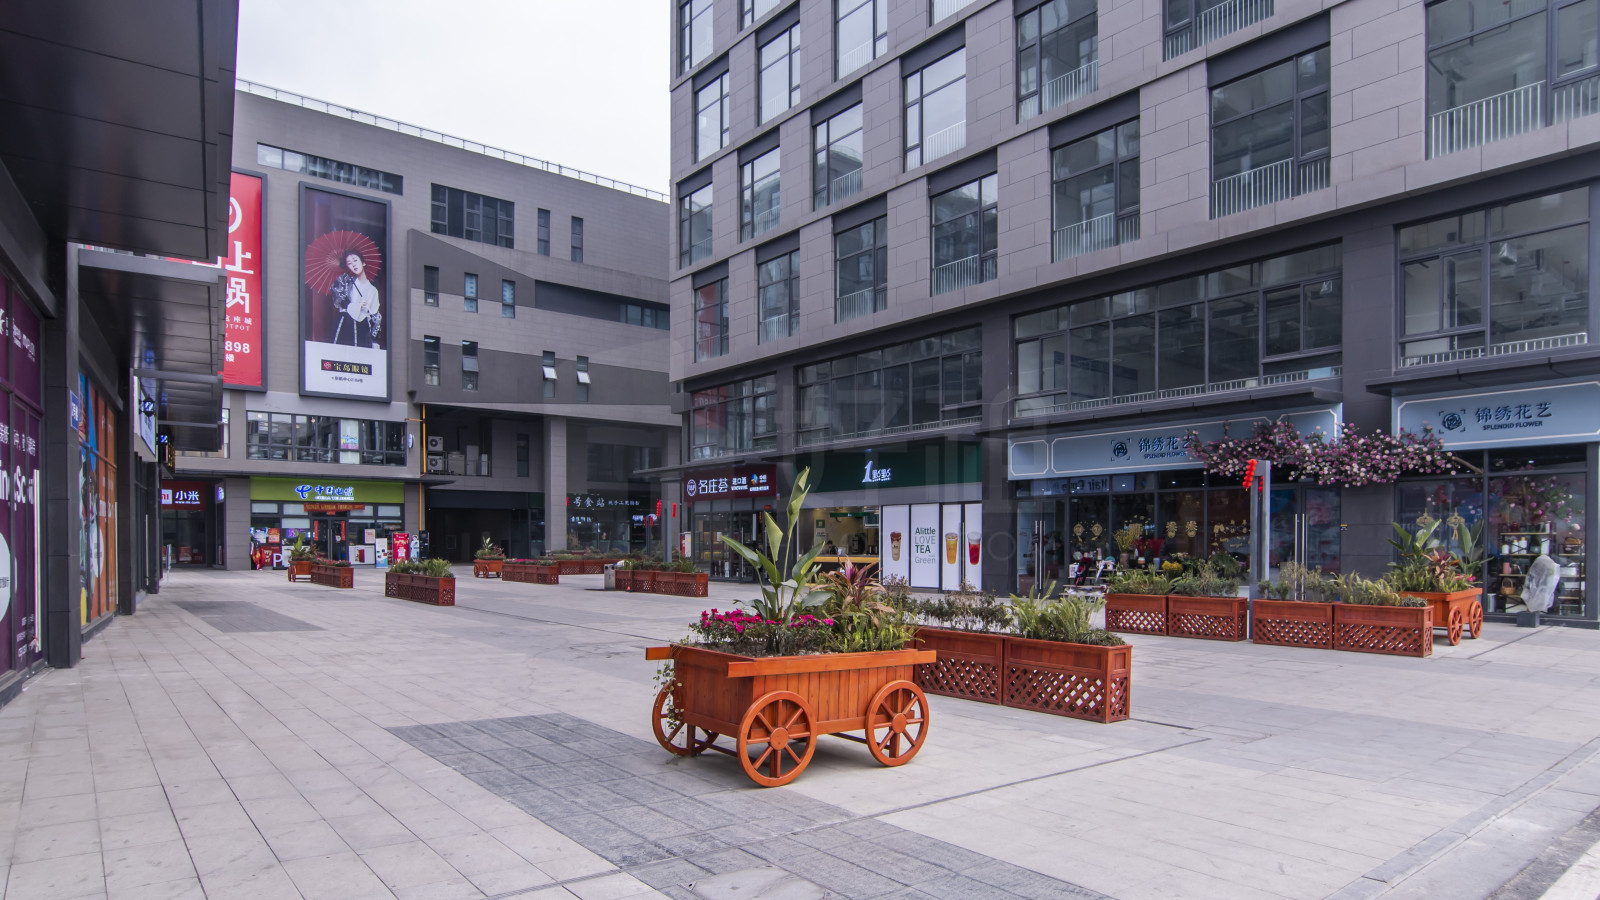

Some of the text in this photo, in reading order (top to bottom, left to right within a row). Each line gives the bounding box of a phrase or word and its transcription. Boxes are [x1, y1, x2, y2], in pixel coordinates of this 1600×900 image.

[1475, 402, 1552, 423] 锦绣花艺
[1483, 420, 1543, 431] SPLENDID FLOWER
[698, 477, 729, 494] 名庄荟
[175, 490, 200, 500] 小米
[914, 536, 936, 544] LOVE
[914, 544, 931, 554] TEA
[914, 556, 936, 564] Green
